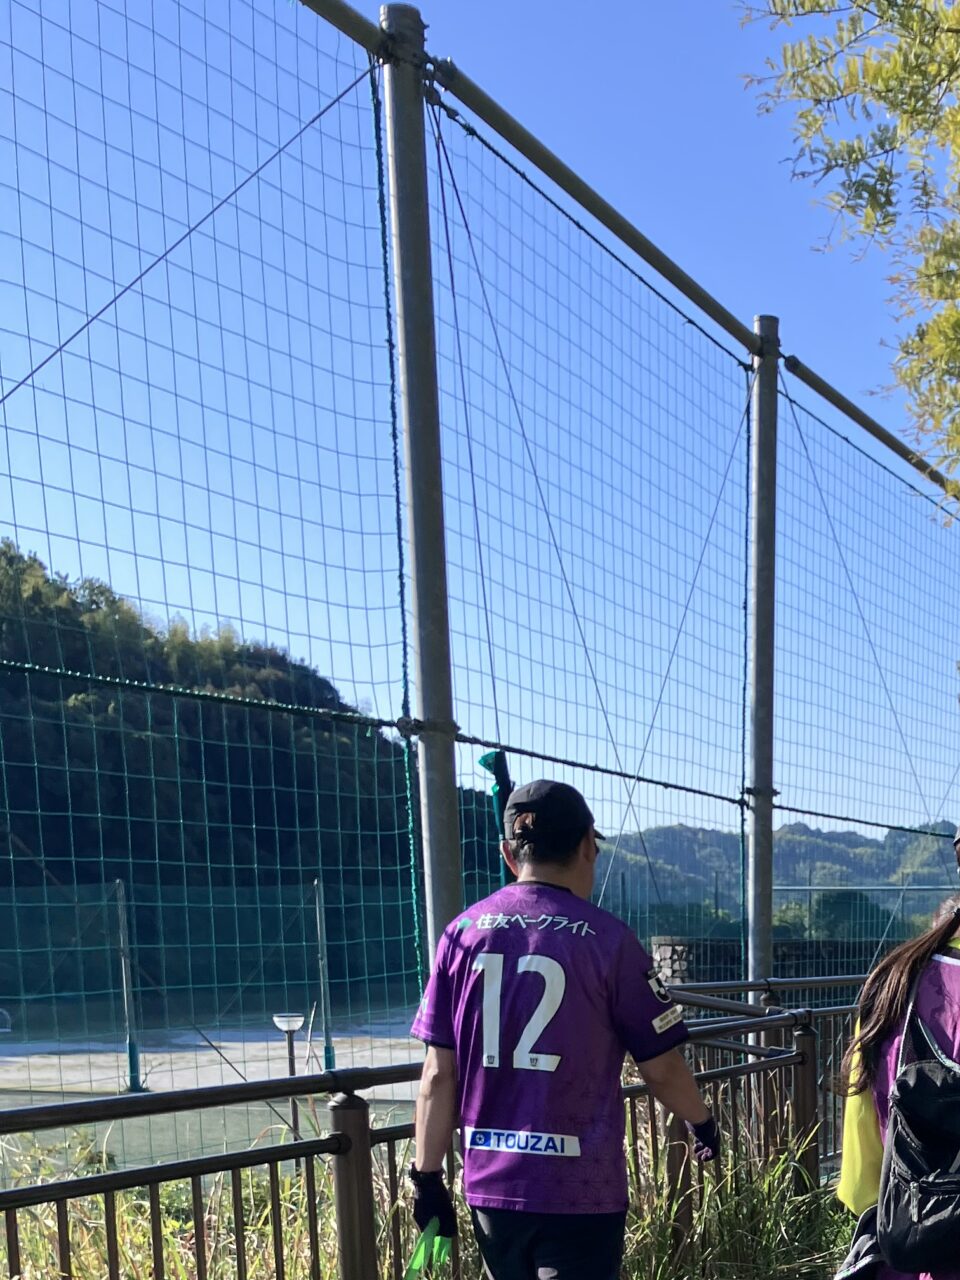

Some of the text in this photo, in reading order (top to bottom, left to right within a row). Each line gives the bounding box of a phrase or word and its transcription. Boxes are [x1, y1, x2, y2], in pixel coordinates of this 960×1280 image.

[476, 912, 596, 936] 住友ベークライト
[471, 952, 566, 1072] 12
[493, 1132, 564, 1153] TOUZAI
